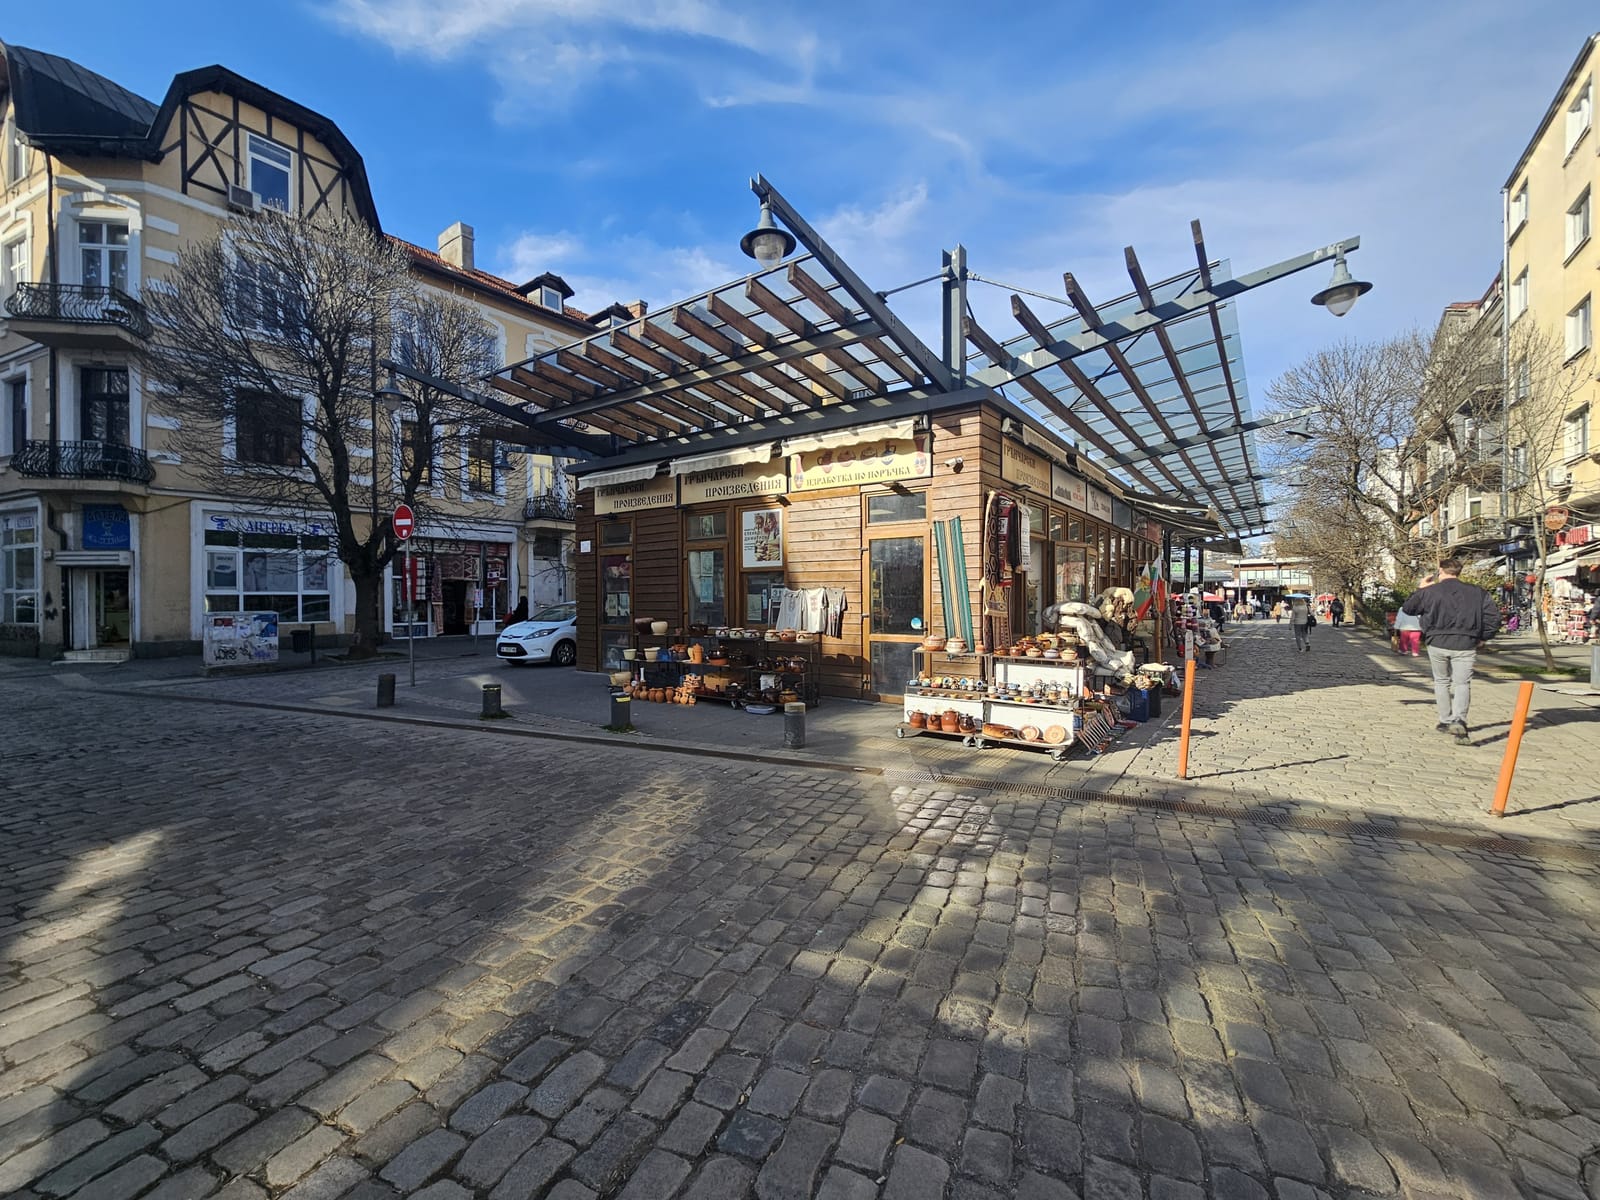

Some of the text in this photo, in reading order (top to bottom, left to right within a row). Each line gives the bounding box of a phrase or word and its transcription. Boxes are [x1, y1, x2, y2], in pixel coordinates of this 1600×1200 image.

[684, 467, 744, 486] ГРЪНЧАРСКИ
[854, 472, 866, 482] ПО
[868, 466, 911, 479] ПОРЪЧКА
[705, 479, 781, 498] ПРОИЗВЕДЕНИЯ
[613, 493, 673, 509] ПРОИЗВЕДЕНИЯ
[246, 521, 294, 534] АПТЕКА
